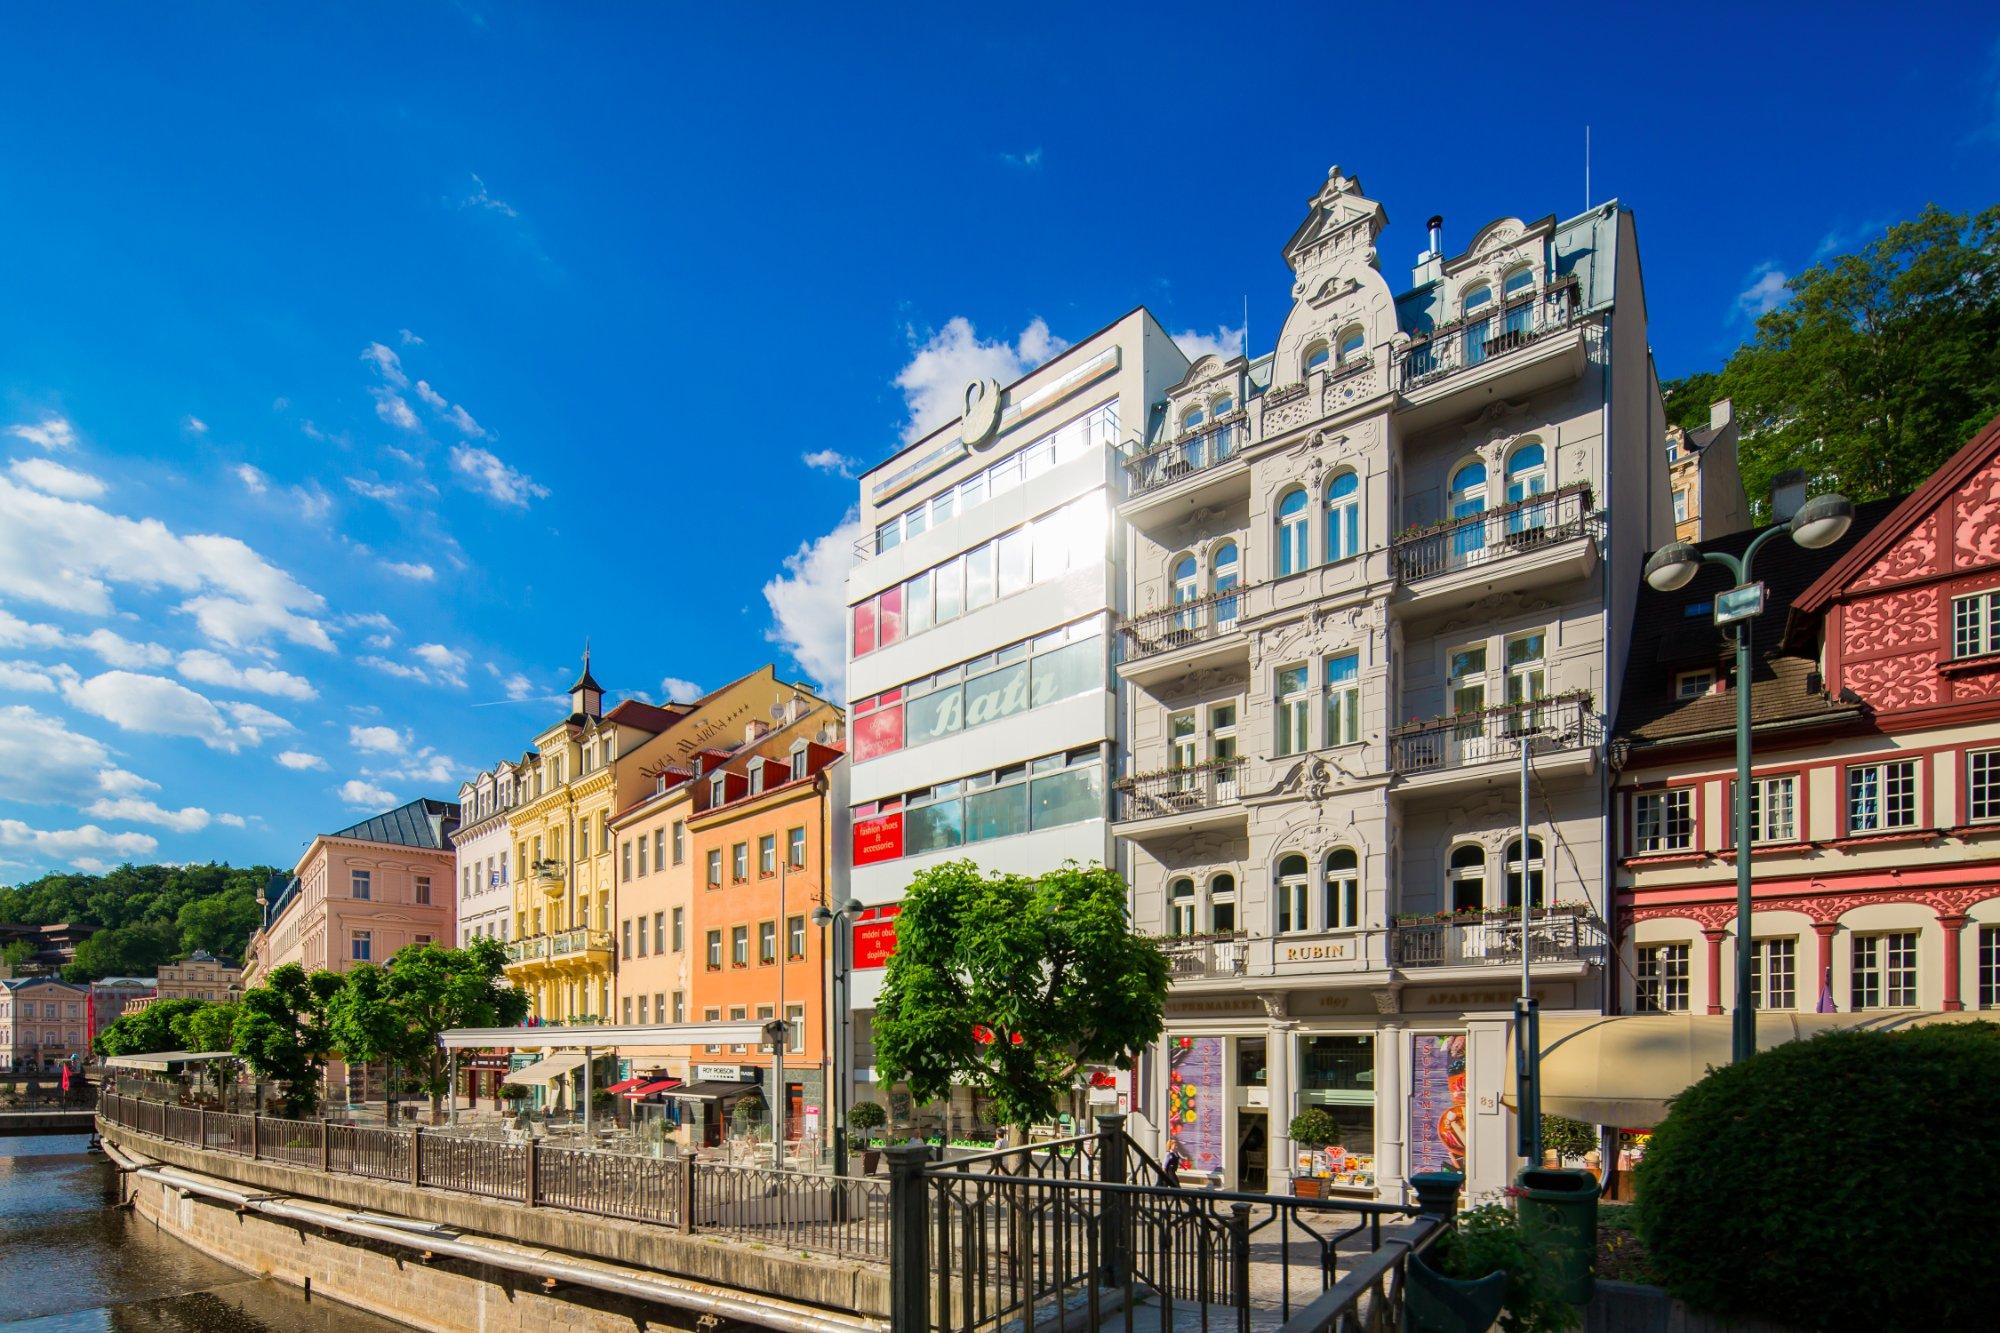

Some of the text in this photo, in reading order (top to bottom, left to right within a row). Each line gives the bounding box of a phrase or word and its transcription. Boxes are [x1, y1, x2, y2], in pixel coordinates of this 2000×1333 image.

[860, 822, 898, 836] fashion shoes
[863, 842, 894, 853] accessories
[1287, 945, 1344, 960] RUBIN
[1166, 1001, 1257, 1012] SUPERMARKET
[1422, 1044, 1432, 1165] SUPERMARKET
[1480, 1096, 1495, 1109] 83
